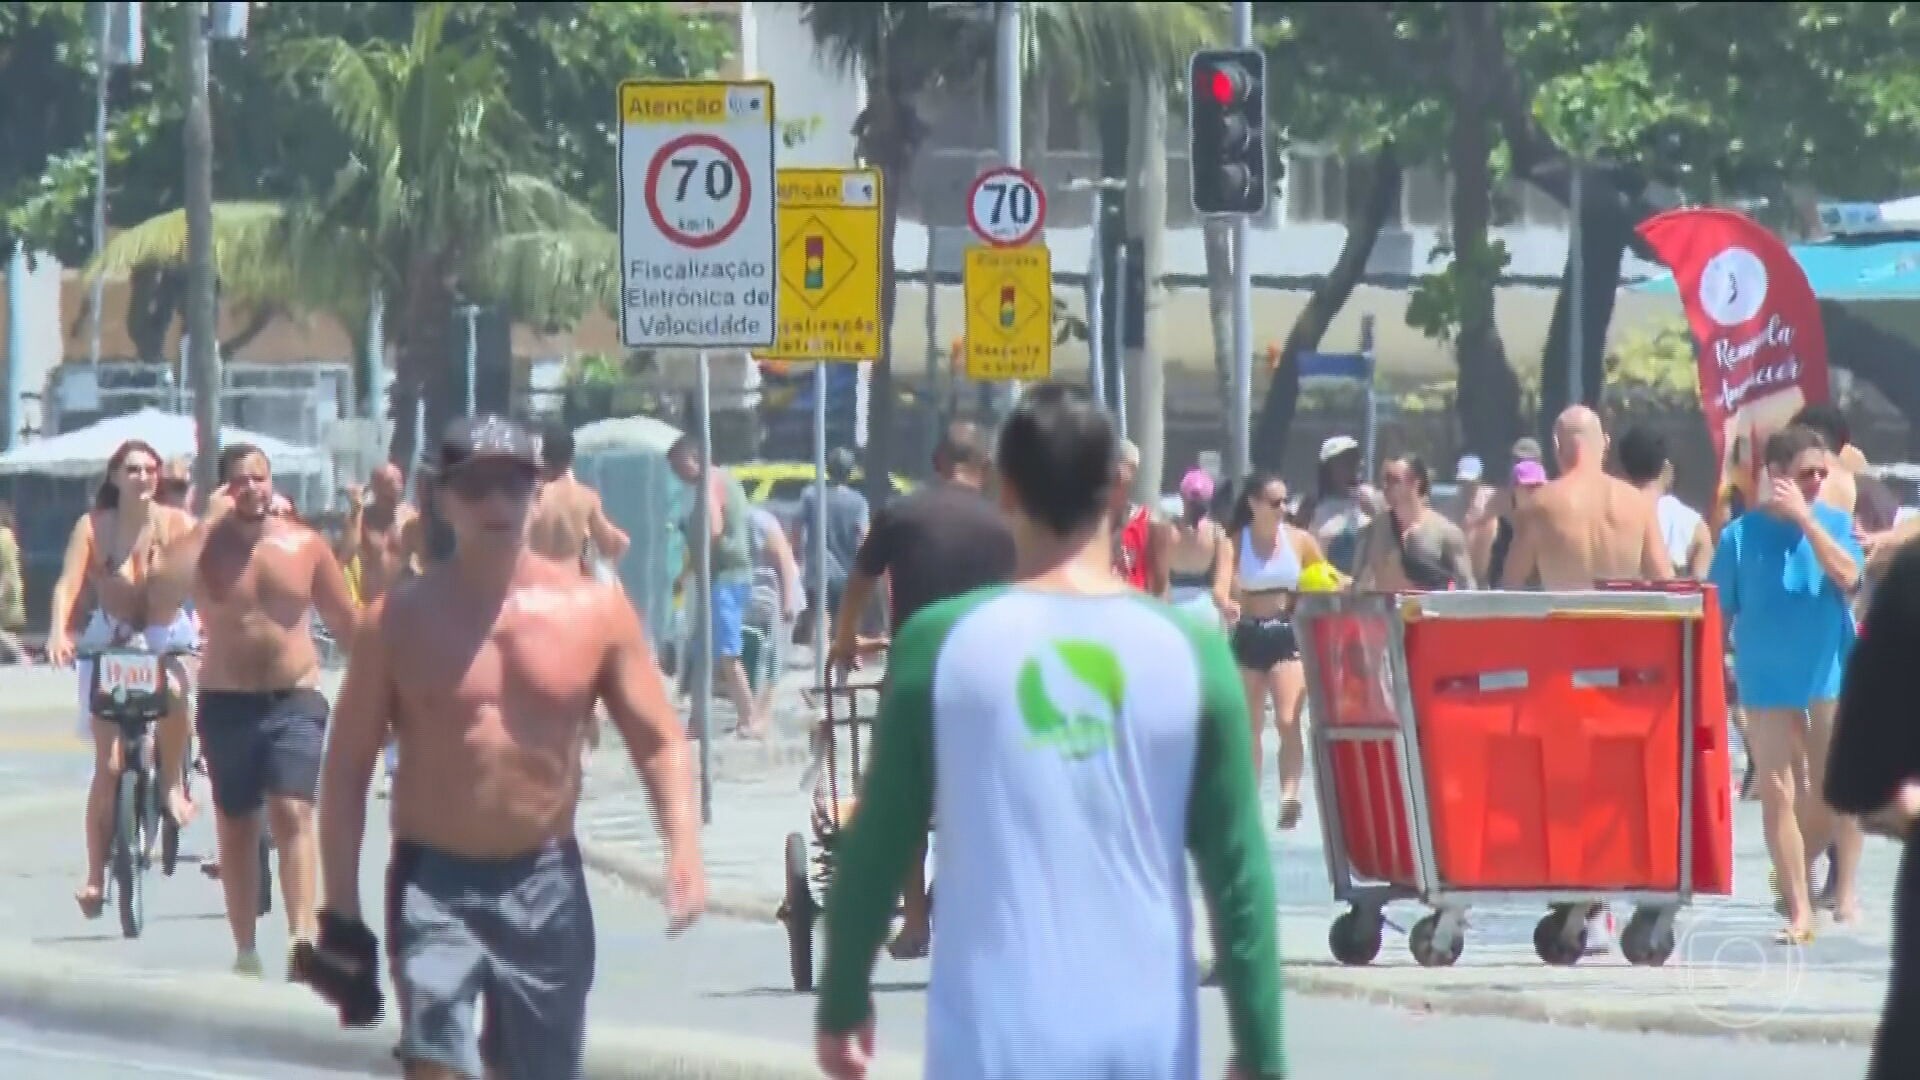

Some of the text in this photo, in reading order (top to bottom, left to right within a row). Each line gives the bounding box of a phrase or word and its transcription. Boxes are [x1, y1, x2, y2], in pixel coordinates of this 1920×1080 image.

[629, 90, 722, 116] Atenção
[671, 159, 733, 202] 70
[983, 184, 1032, 224] 70
[678, 216, 715, 231] km/h
[630, 258, 765, 282] Fiscalização
[627, 286, 770, 308] Eletrônica de
[639, 314, 760, 338] Velocidade
